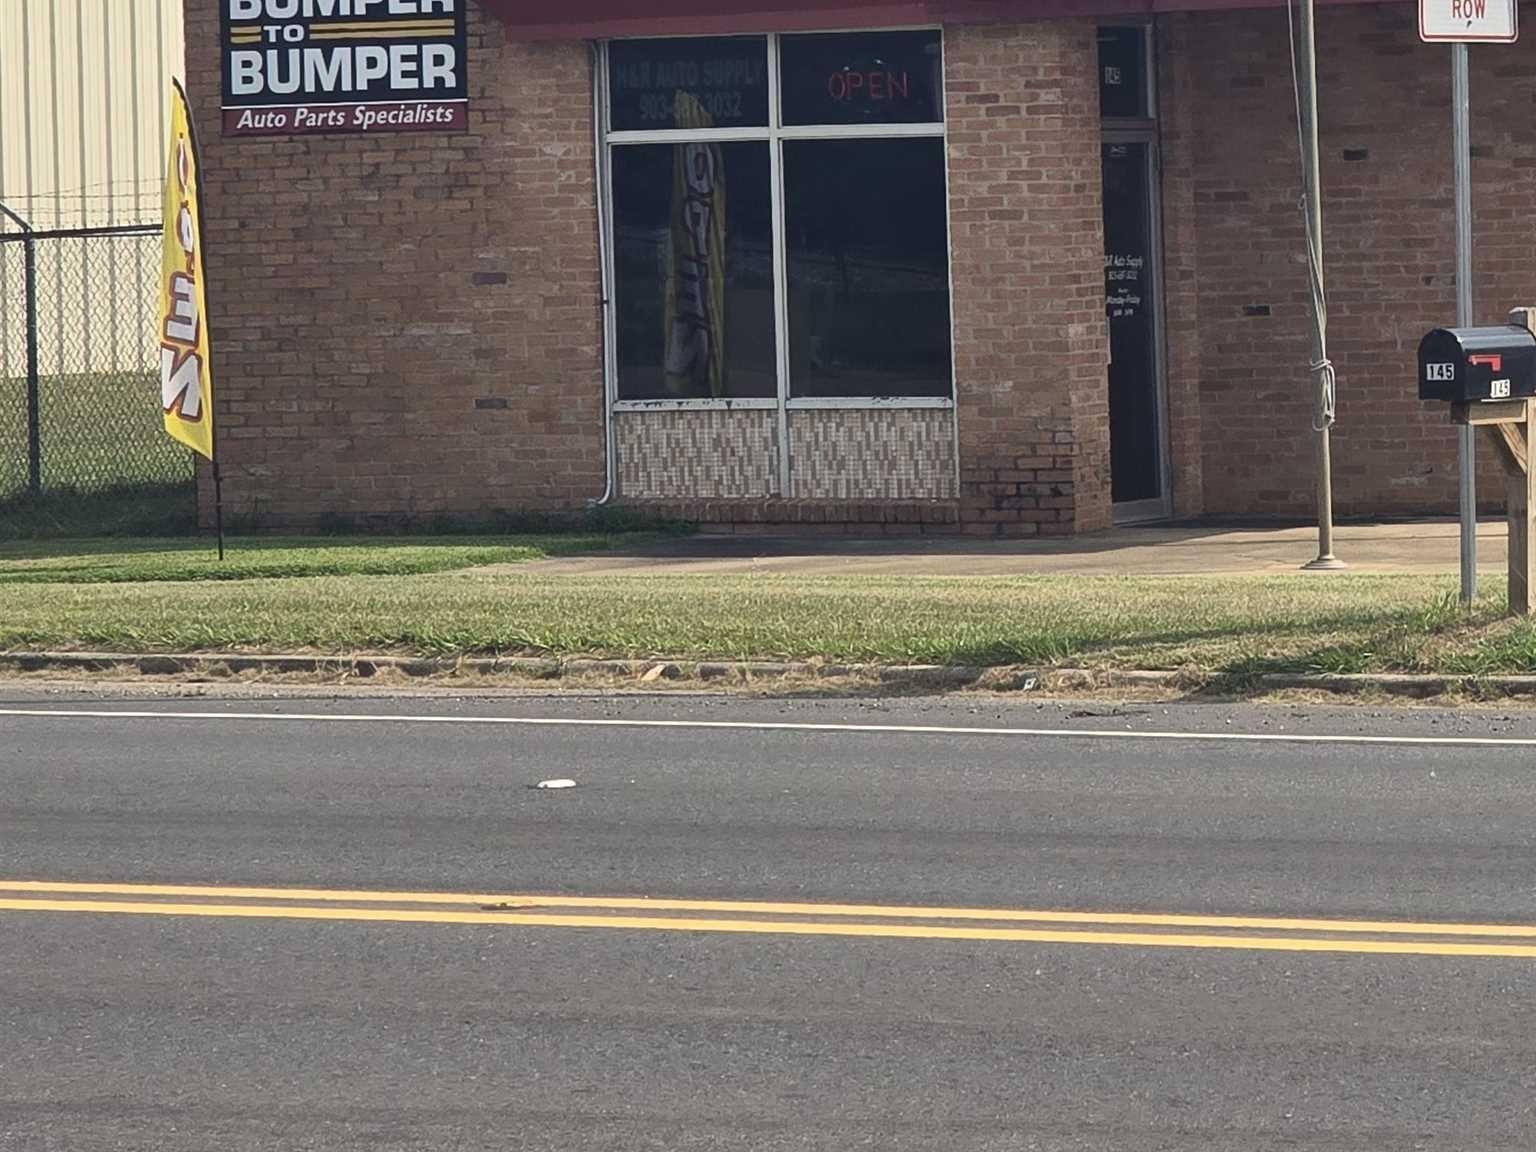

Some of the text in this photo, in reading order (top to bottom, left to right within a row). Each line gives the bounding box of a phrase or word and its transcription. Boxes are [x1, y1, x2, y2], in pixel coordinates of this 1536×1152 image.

[263, 24, 305, 42] TO
[230, 43, 456, 95] BUMPER
[826, 71, 909, 99] OPEN
[237, 104, 453, 130] Auto Parts Specialists
[1429, 364, 1453, 379] 145
[1493, 380, 1509, 397] 145
